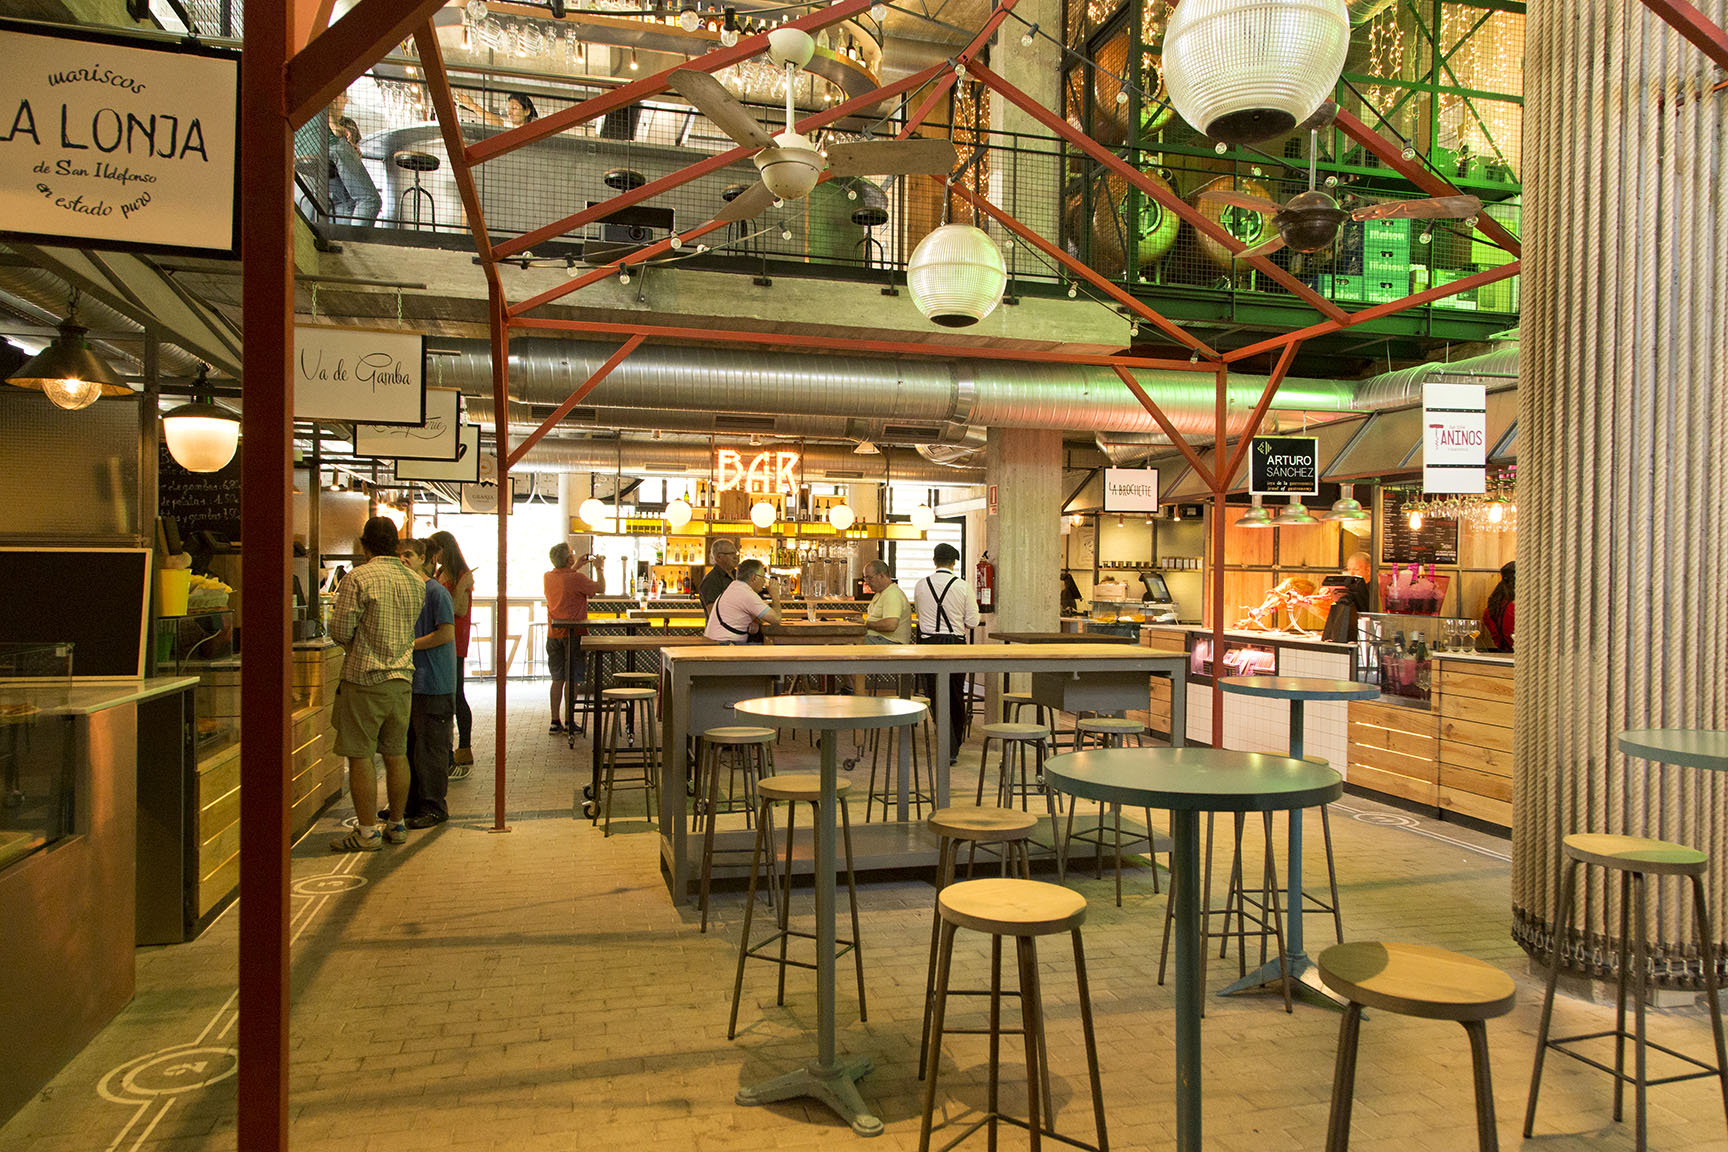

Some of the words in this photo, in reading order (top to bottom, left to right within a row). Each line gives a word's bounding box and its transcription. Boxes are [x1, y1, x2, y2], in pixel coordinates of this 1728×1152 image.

[48, 64, 146, 94] mariscos
[0, 98, 41, 145] A
[61, 103, 208, 162] LONJA
[33, 161, 51, 174] de
[55, 160, 89, 176] San
[94, 162, 157, 185] Ildefonso
[55, 195, 112, 217] estado
[120, 191, 151, 219] puro
[301, 348, 328, 381] Va
[333, 359, 348, 381] de
[355, 352, 411, 393] Gamba
[1429, 424, 1483, 450] TANINOS
[717, 448, 799, 494] BAR
[1266, 455, 1312, 466] ARTURO
[1266, 465, 1314, 478] SÁNCHEZ
[1109, 482, 1118, 496] LA
[1119, 484, 1152, 497] BROCHETTE
